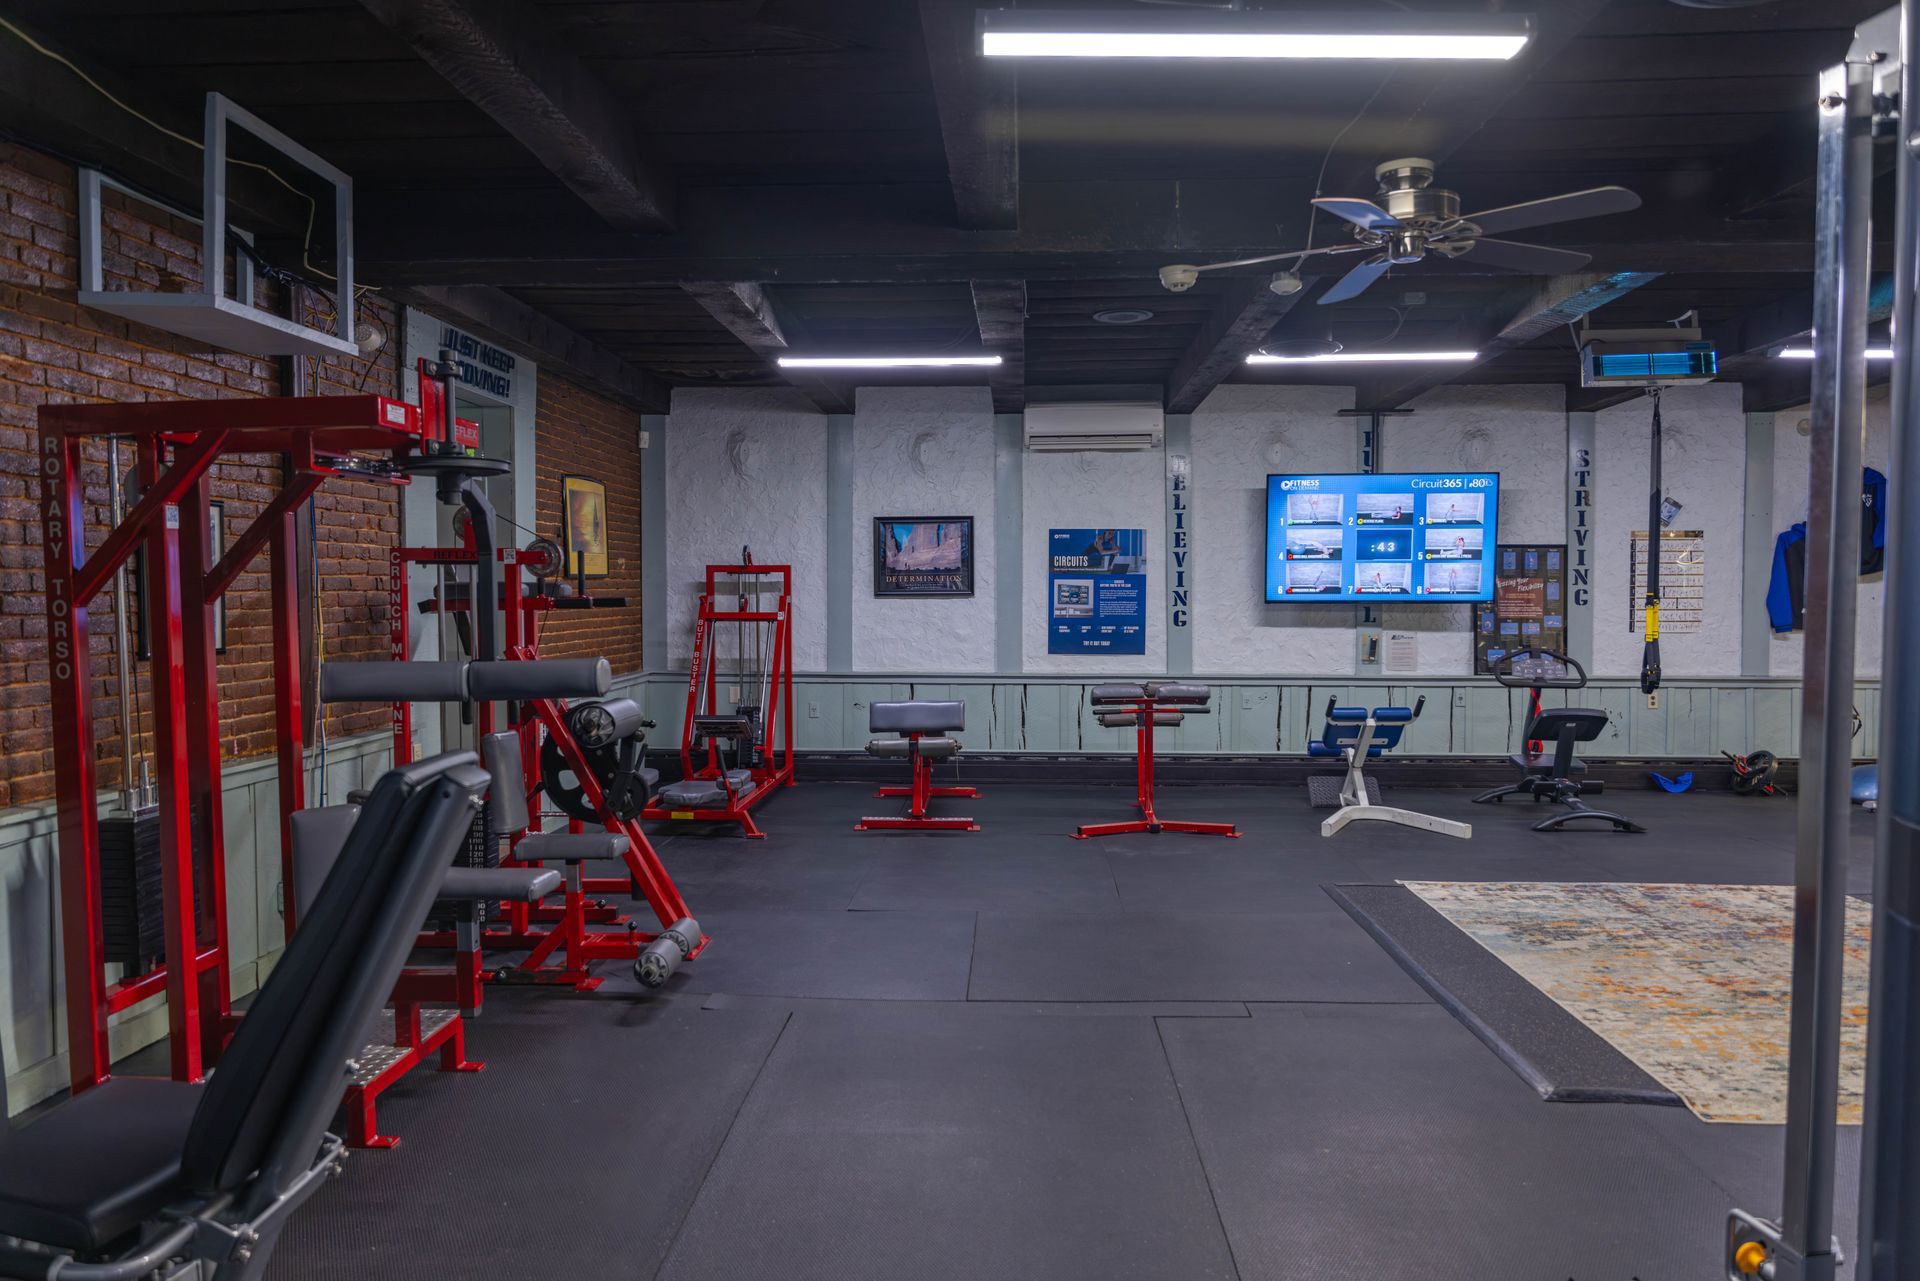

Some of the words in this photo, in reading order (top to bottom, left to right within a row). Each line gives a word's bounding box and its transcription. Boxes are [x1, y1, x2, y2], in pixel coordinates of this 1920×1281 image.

[480, 344, 516, 374] KEEP
[456, 360, 511, 398] OVING!
[1411, 478, 1462, 489] Circuit365
[44, 437, 63, 560] ROTARY
[1348, 517, 1354, 526] 2
[1419, 516, 1425, 526] 3
[1573, 449, 1592, 606] STRIVING
[1054, 555, 1088, 567] CIRCUITS
[1278, 551, 1284, 561] 4
[1417, 551, 1423, 561] 5
[886, 575, 962, 583] DETERMINATION
[390, 552, 401, 630] CRUNCH
[1278, 585, 1284, 595] 6
[1348, 585, 1354, 595] 7
[1416, 585, 1423, 595] 8
[52, 579, 71, 680] TORSO
[695, 619, 704, 646] BUTT
[689, 651, 700, 693] BUSTER
